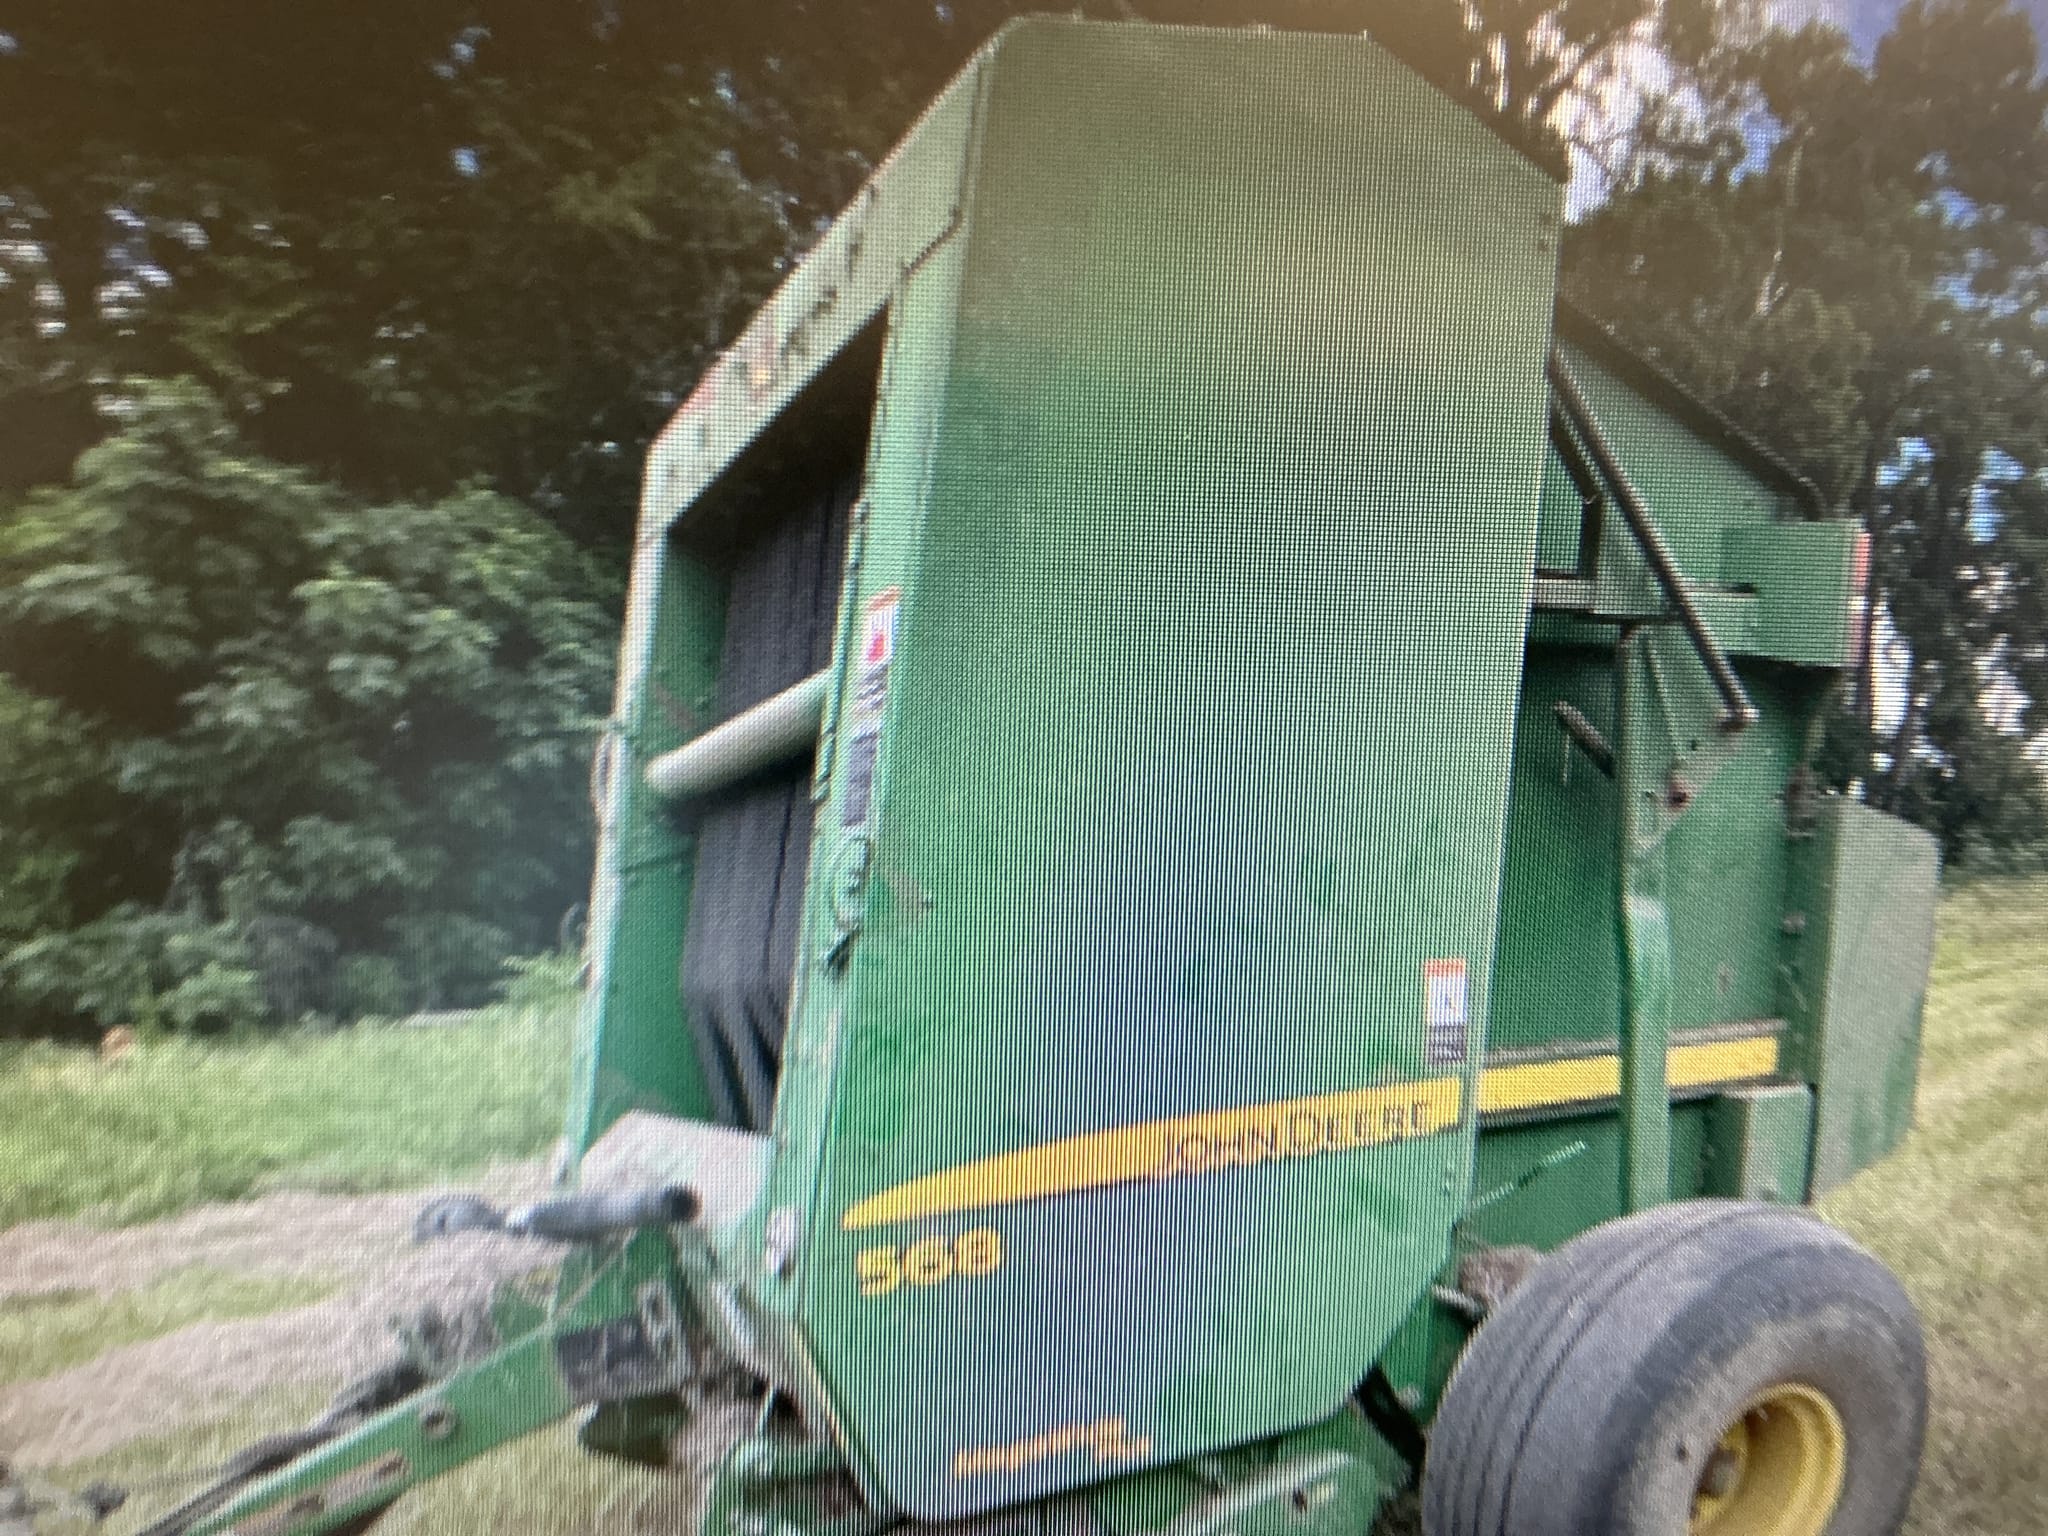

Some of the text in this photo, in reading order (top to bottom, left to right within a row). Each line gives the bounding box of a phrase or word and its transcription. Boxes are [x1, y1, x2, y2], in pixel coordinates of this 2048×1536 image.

[1162, 1100, 1432, 1171] JOHN DEERE
[855, 1226, 1004, 1298] 568
